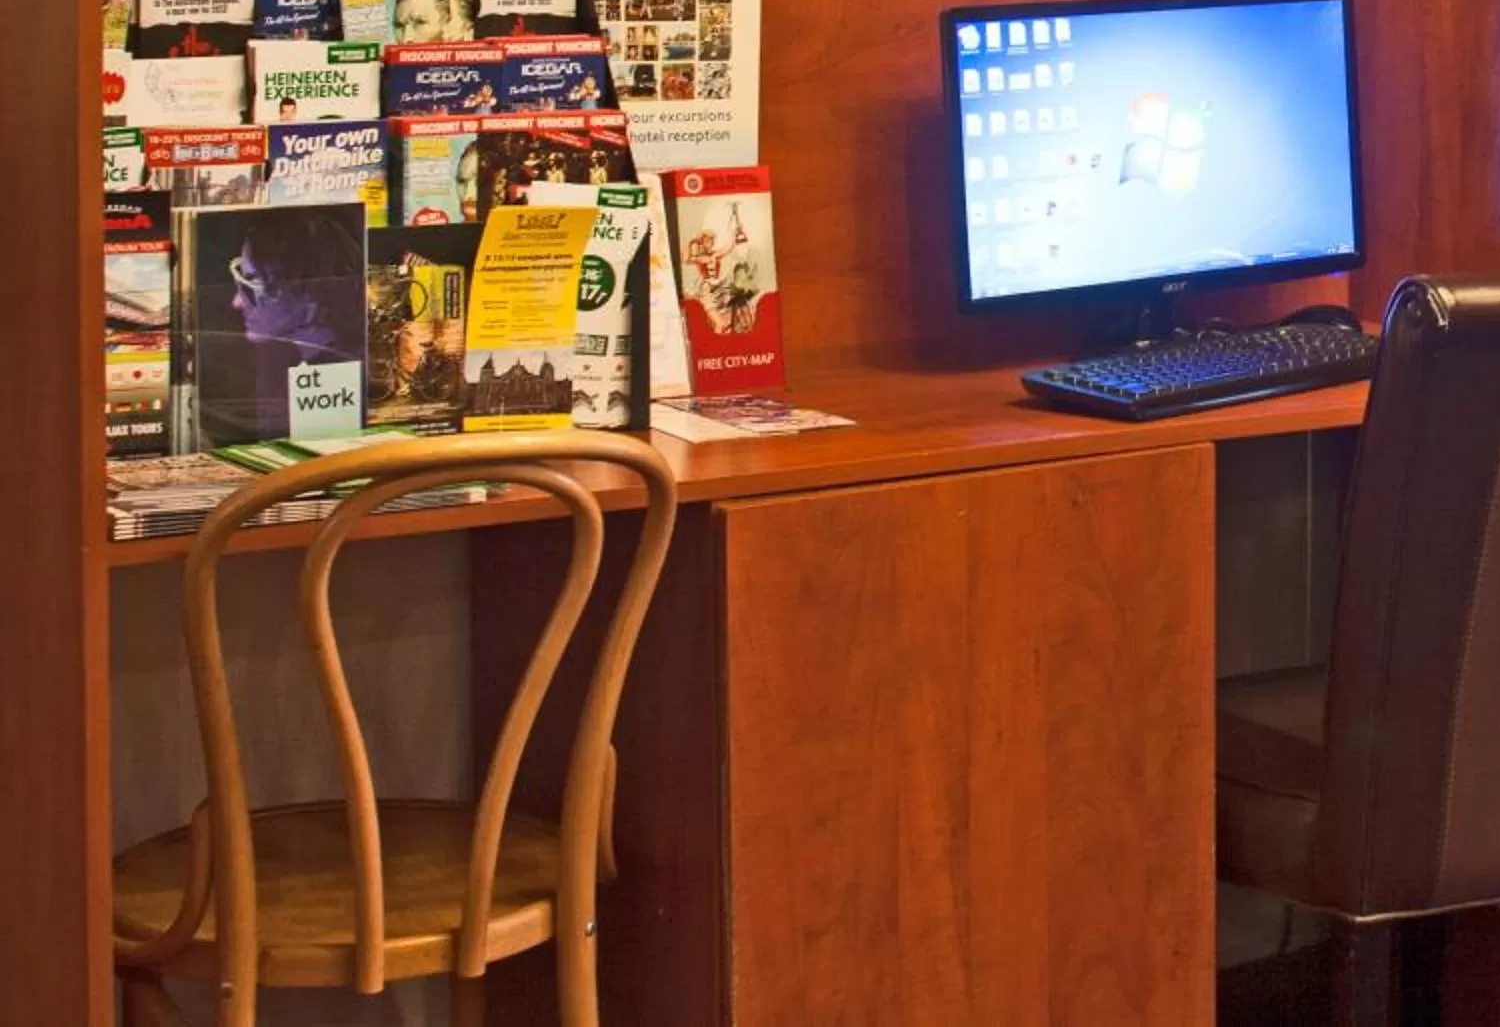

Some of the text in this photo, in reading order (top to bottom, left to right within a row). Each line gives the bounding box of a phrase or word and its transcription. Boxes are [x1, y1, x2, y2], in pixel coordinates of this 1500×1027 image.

[521, 63, 583, 76] ICEBAR
[264, 70, 347, 85] HEINEKEN
[415, 71, 481, 84] ICEBAR
[264, 83, 359, 100] EXPERIENCE
[659, 110, 733, 123] excursions
[282, 128, 379, 155] Your own
[630, 130, 731, 145] hotel reception
[698, 358, 722, 370] FREE
[296, 370, 321, 389] at
[296, 388, 355, 411] work
